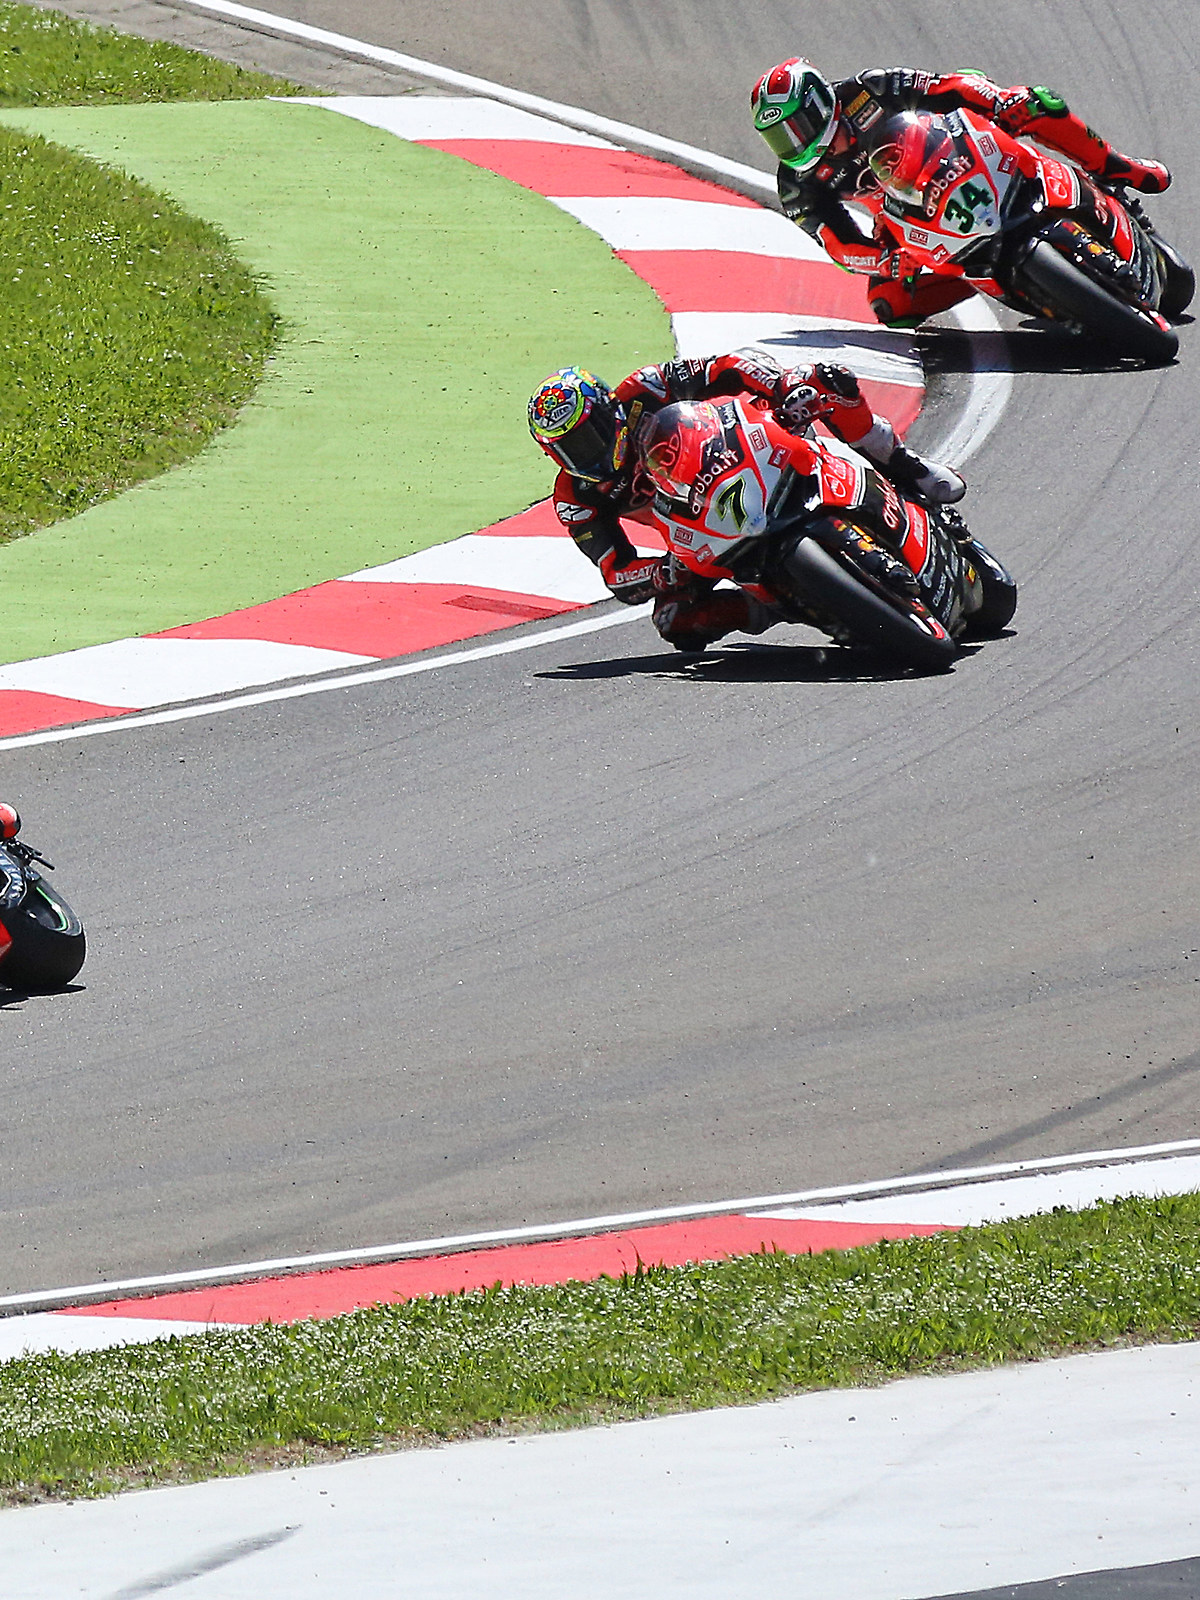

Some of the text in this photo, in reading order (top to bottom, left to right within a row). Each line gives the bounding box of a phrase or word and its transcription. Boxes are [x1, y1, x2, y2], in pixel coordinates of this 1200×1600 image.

[760, 108, 781, 123] Arai
[945, 180, 994, 234] 34
[733, 359, 776, 390] DUCATI
[691, 449, 738, 515] aruba.it
[716, 475, 747, 533] 7
